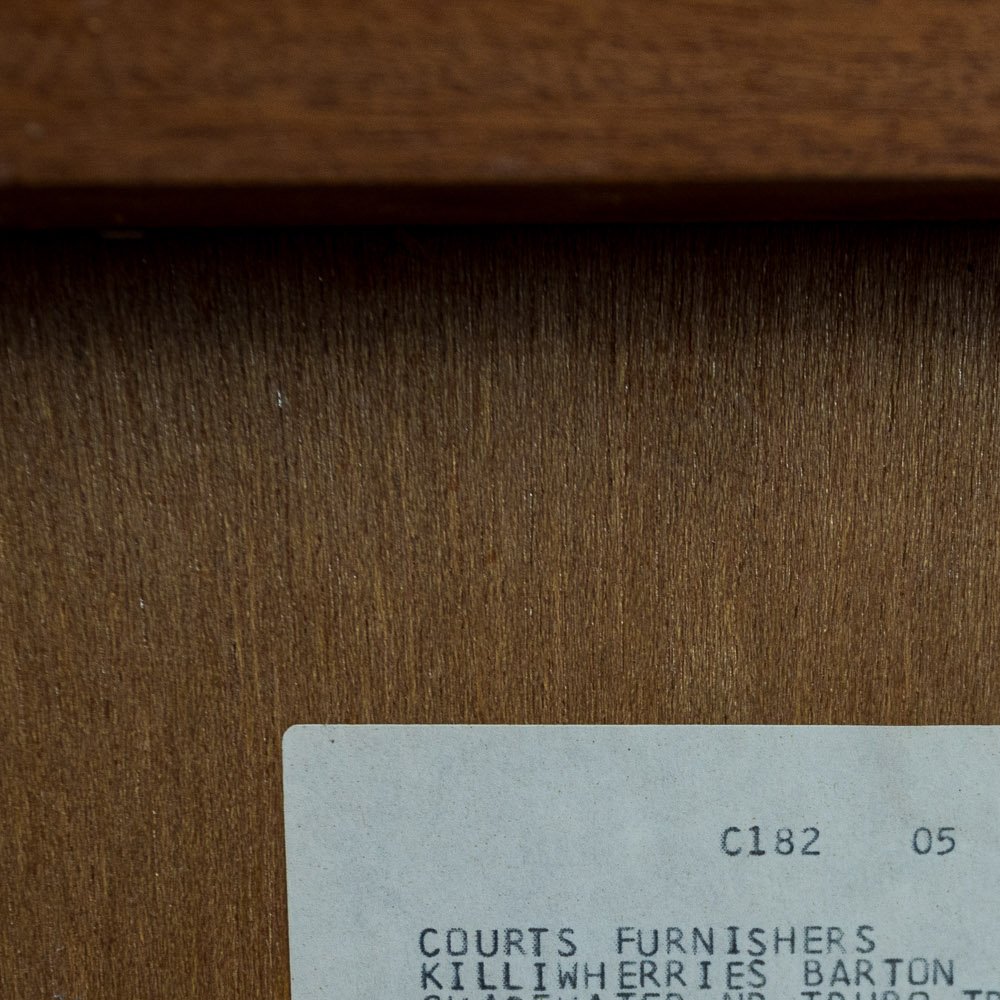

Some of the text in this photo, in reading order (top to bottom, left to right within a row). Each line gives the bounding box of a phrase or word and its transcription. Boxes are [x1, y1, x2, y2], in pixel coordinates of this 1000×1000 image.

[720, 824, 821, 858] C182
[911, 826, 957, 857] 05
[418, 926, 578, 959] COURTS
[616, 924, 876, 957] FURNISHERS
[420, 957, 955, 991] KILLIWHERRIES BARTON
